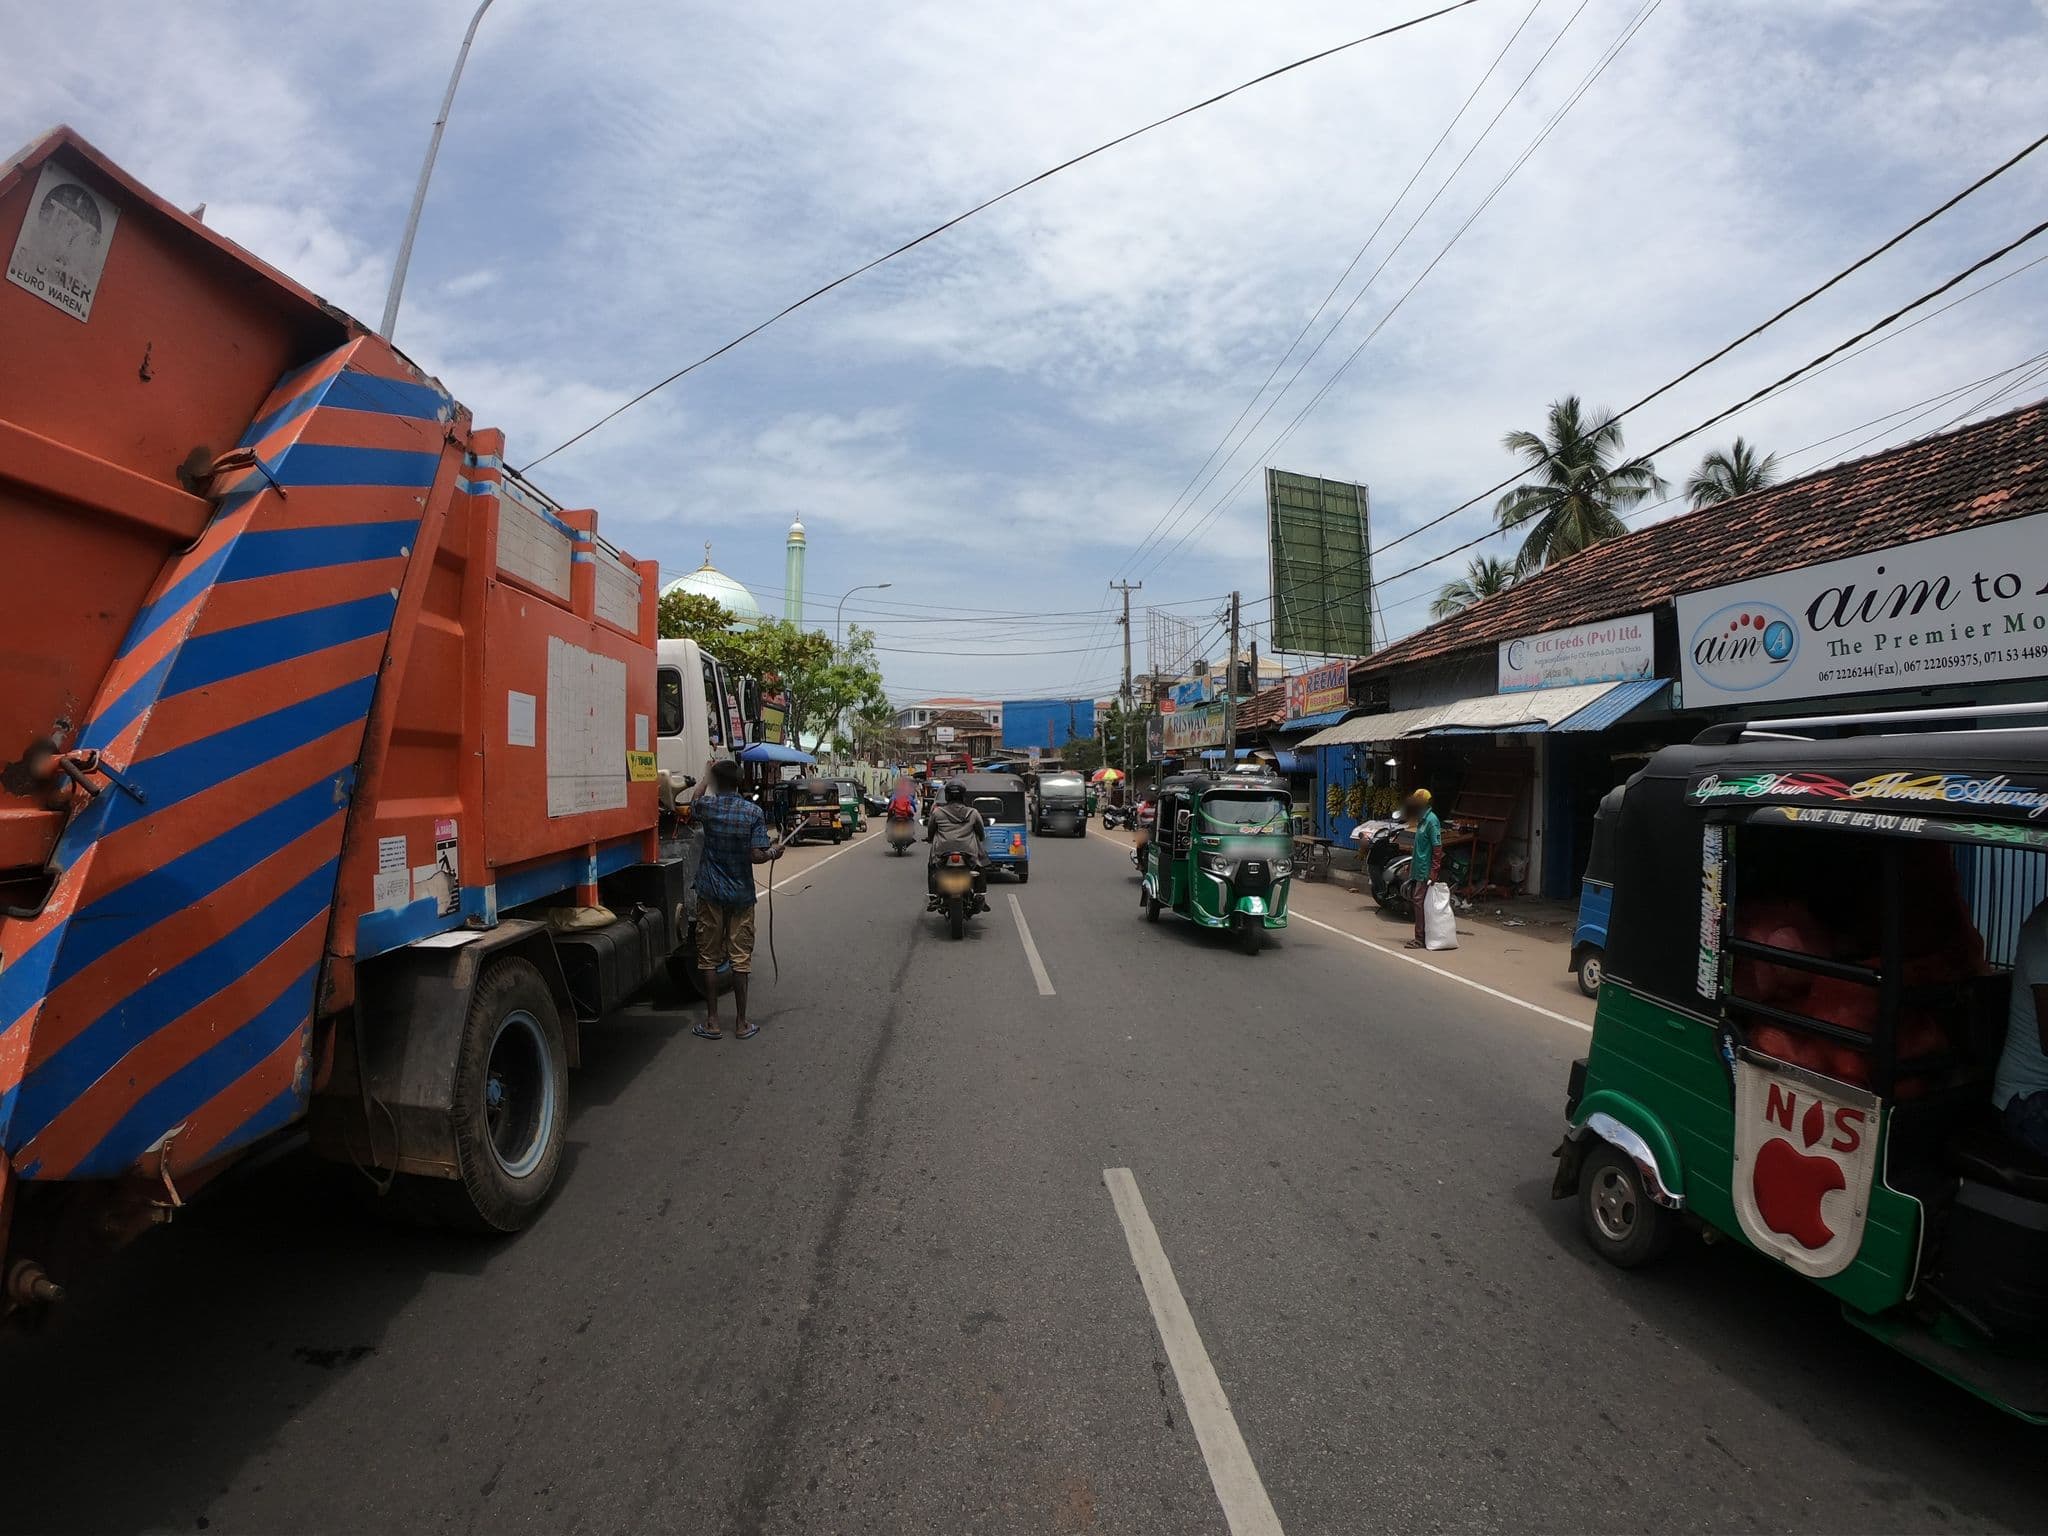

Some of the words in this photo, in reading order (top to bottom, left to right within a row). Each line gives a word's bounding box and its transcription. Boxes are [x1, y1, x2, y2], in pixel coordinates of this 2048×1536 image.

[16, 270, 45, 292] EURO
[48, 286, 83, 314] WAREN
[1804, 566, 1961, 632] aim
[1971, 571, 2022, 603] to
[1535, 639, 1553, 653] CIC
[1555, 635, 1584, 651] Feeds
[1694, 632, 1761, 665] aim
[1827, 637, 1863, 657] The
[1874, 622, 1992, 651] Premier
[1818, 670, 1835, 683] 067
[1836, 661, 1901, 681] 2226244(Fax),
[1904, 659, 1921, 673] 067
[1924, 652, 1982, 671] 222059375,
[1984, 650, 2003, 664] 071
[2006, 648, 2019, 662] 53
[2021, 644, 2048, 660] 4489
[1306, 667, 1345, 694] REEMA
[1695, 774, 1740, 804] Open
[1744, 772, 1810, 798] Your
[1799, 808, 1826, 822] LOVE
[1827, 810, 1850, 825] THE
[1850, 812, 1876, 827] LIFE
[1875, 814, 1900, 830] YOU
[1899, 817, 1928, 833] LIVE
